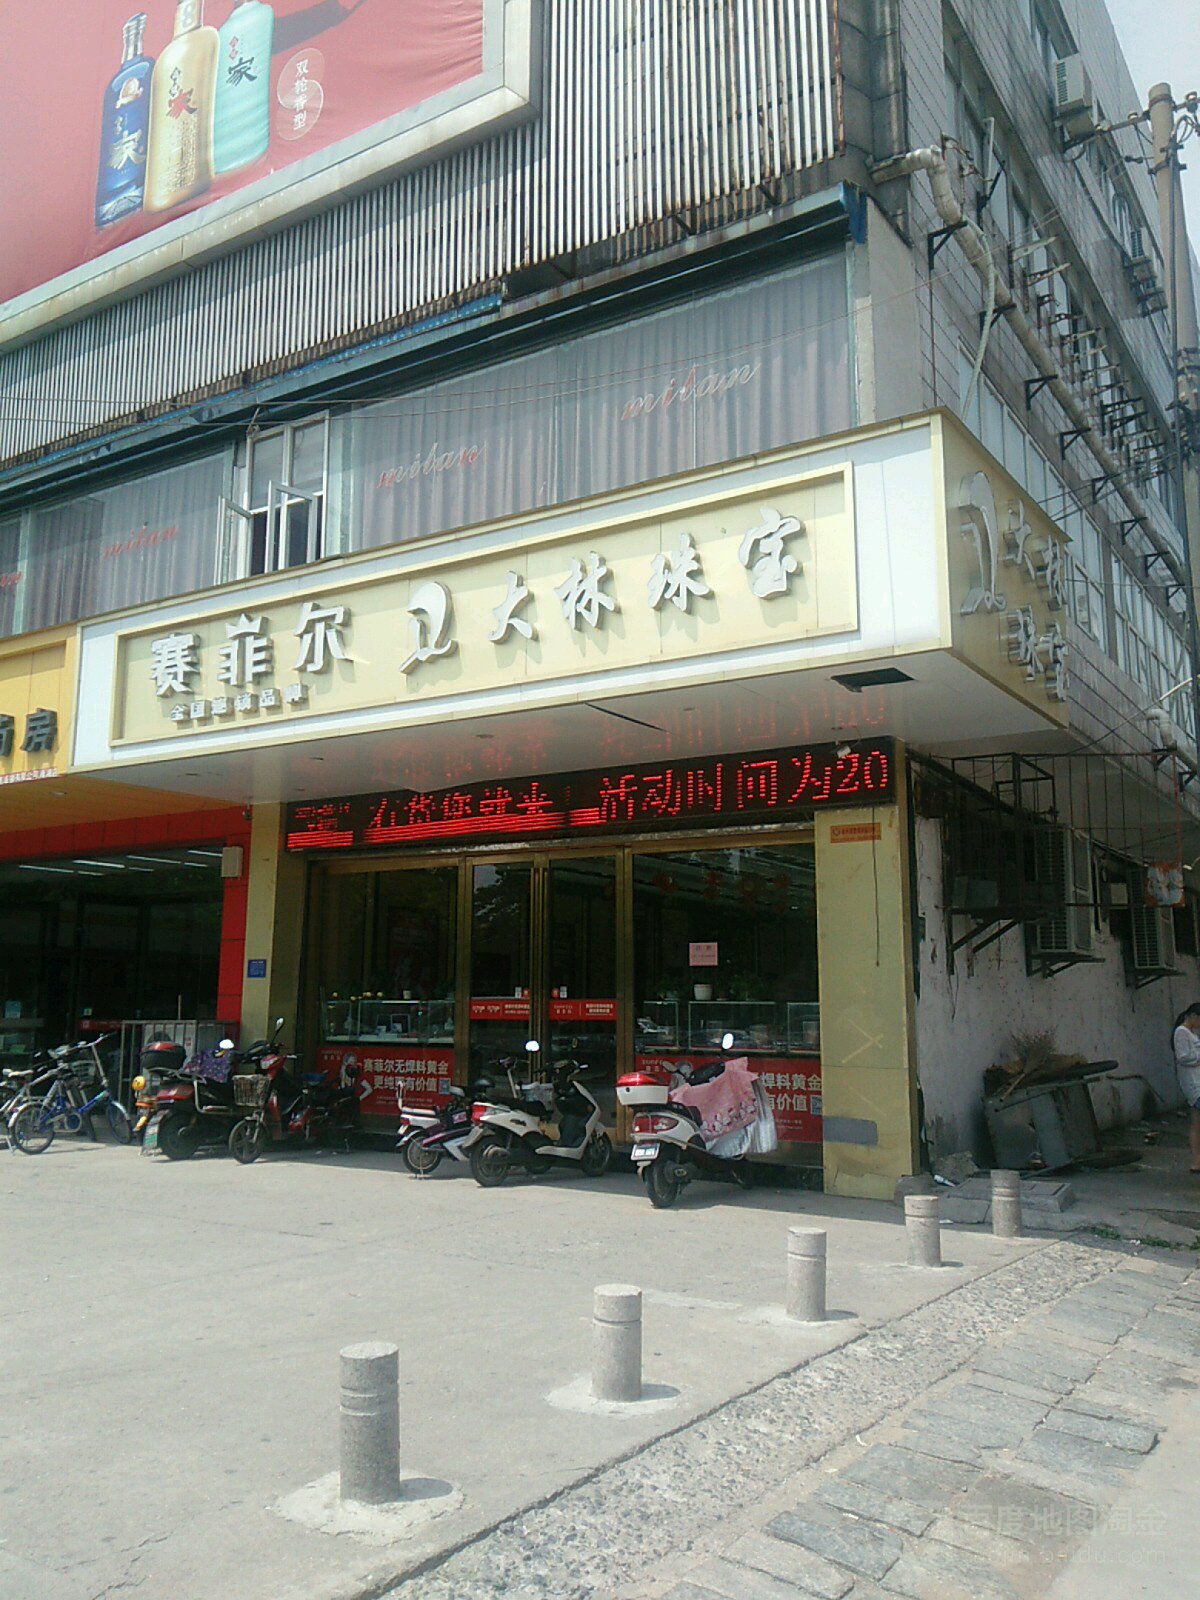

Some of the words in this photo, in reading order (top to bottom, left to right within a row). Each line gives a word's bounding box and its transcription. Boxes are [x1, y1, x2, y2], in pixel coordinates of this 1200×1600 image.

[621, 362, 762, 421] milan
[376, 441, 488, 489] milan
[150, 600, 354, 699] 赛菲尔
[488, 506, 806, 646] 大林珠宝
[363, 1059, 449, 1074] 赛菲尔无焊料黄金
